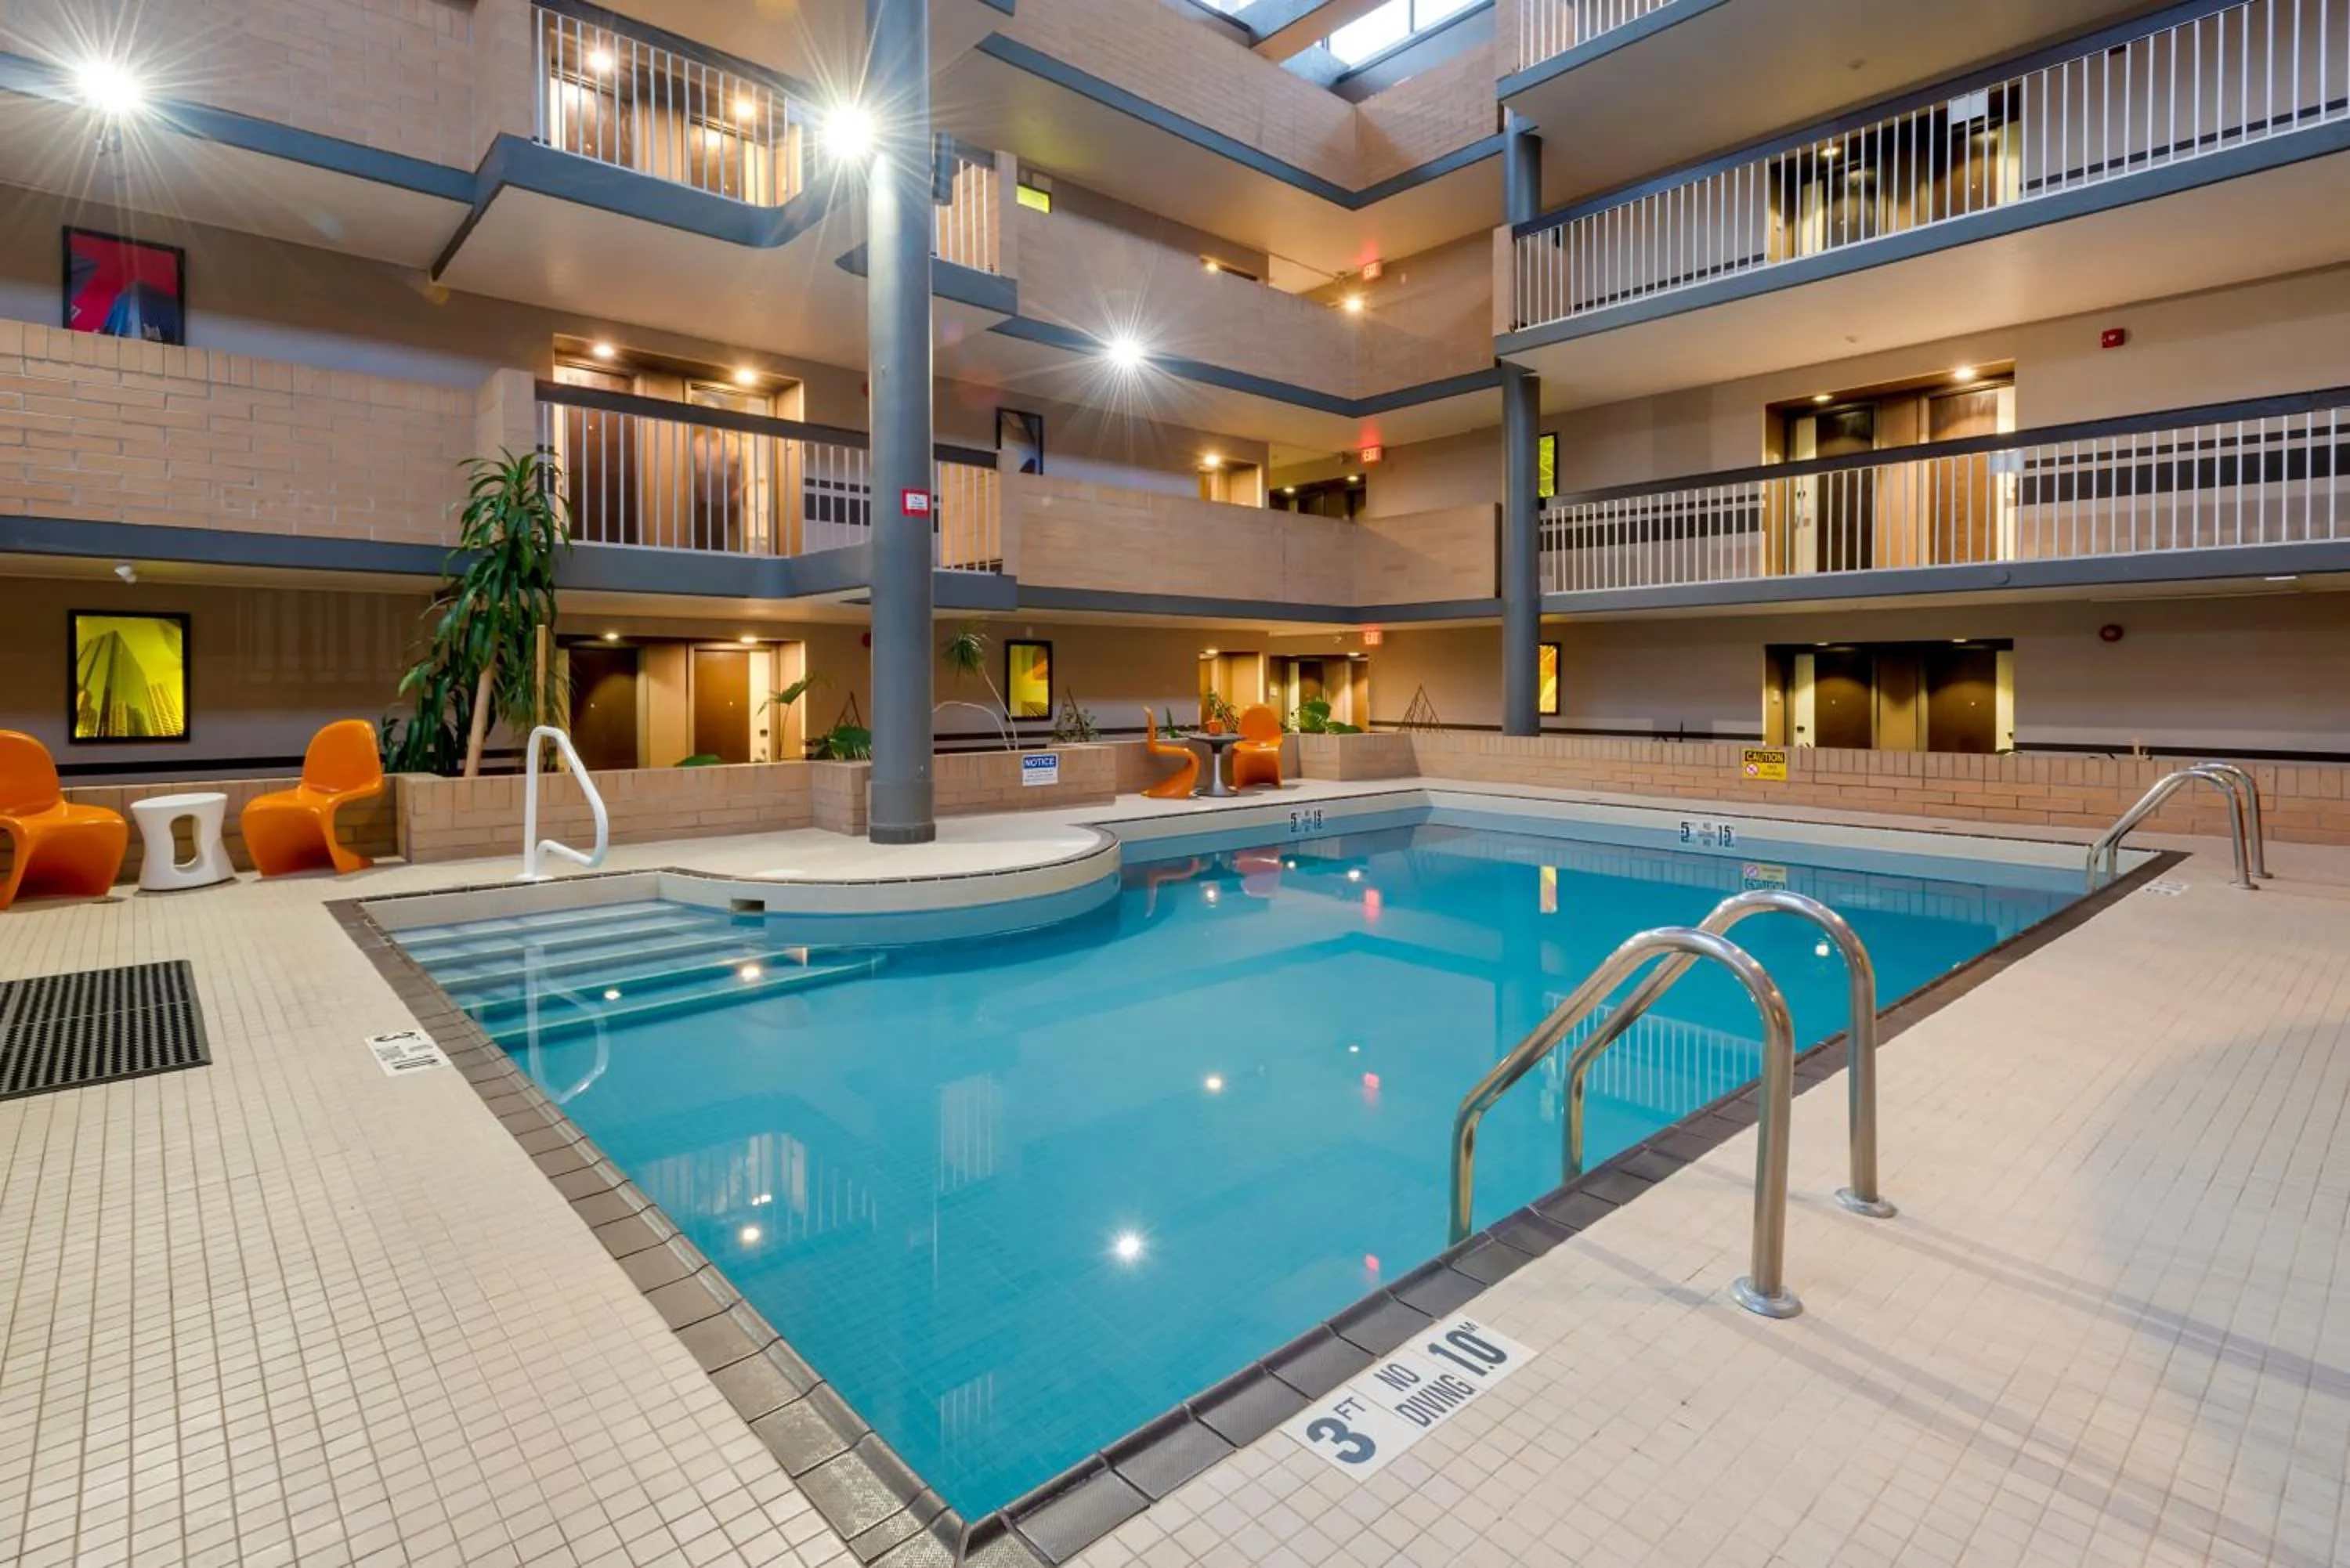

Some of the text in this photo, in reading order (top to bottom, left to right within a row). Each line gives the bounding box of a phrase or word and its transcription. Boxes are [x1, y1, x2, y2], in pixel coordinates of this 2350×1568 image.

[1025, 757, 1055, 767] NOTICE
[1747, 753, 1784, 763] CAUTION
[1374, 1362, 1421, 1392] NO
[1394, 1374, 1477, 1428] DIVING
[1306, 1396, 1376, 1464] 3 FT
